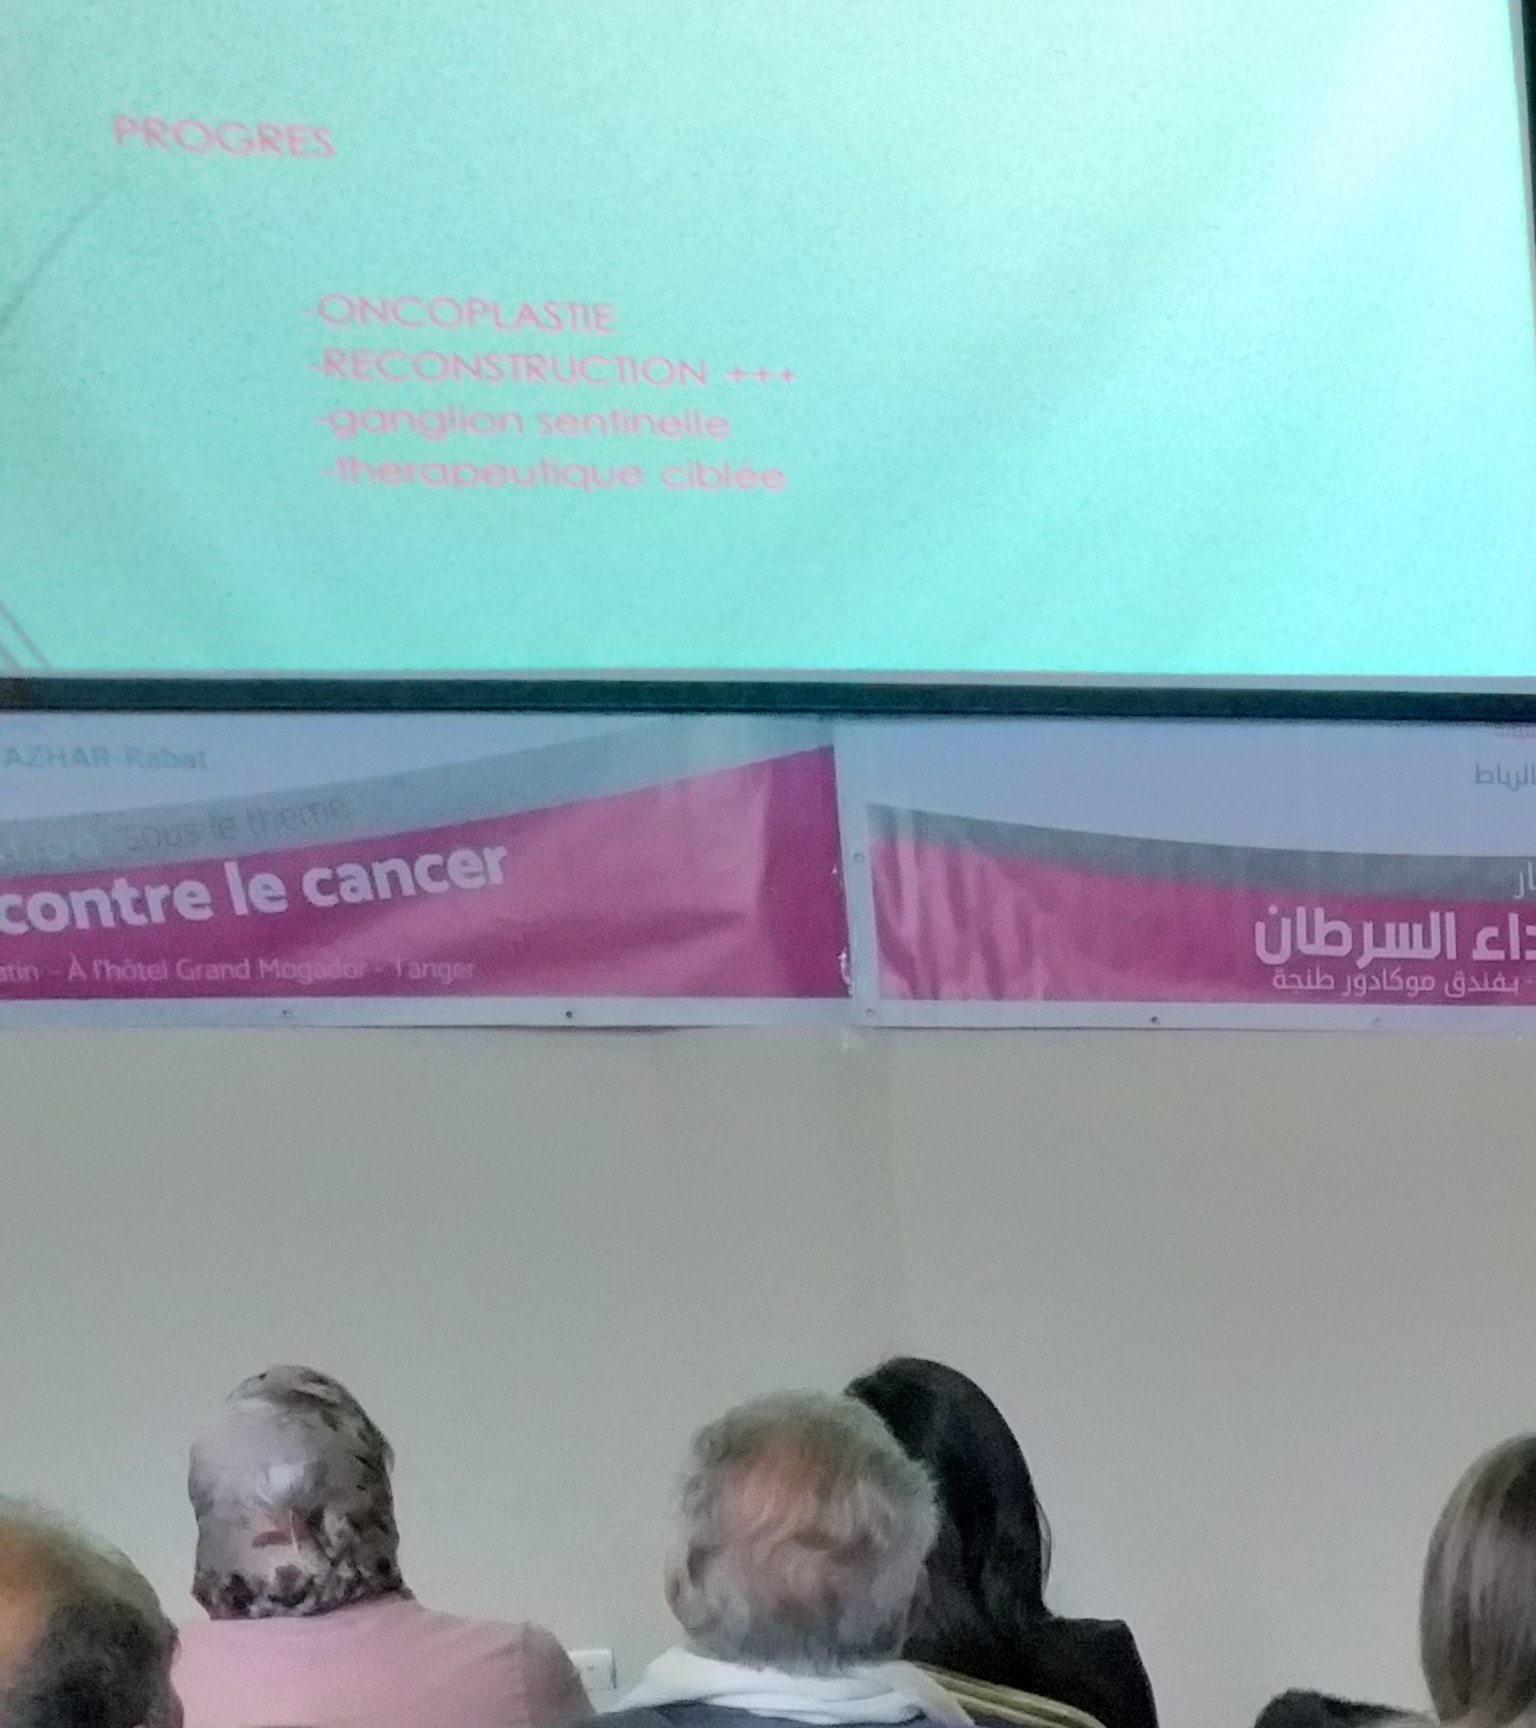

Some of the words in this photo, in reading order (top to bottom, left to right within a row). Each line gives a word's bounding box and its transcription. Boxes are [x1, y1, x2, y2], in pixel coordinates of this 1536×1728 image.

[112, 114, 336, 159] PROGRES
[537, 407, 732, 440] sentinelle
[661, 458, 787, 492] ciblée
[0, 877, 215, 936] contre
[223, 860, 288, 916] le
[302, 845, 507, 908] cancer
[1254, 904, 1457, 971] السرطان
[176, 958, 250, 981] Grand
[258, 957, 367, 985] Mogador
[1272, 966, 1335, 995] طنجة
[1341, 966, 1436, 998] موكادور
[1444, 970, 1520, 999] بفندق
